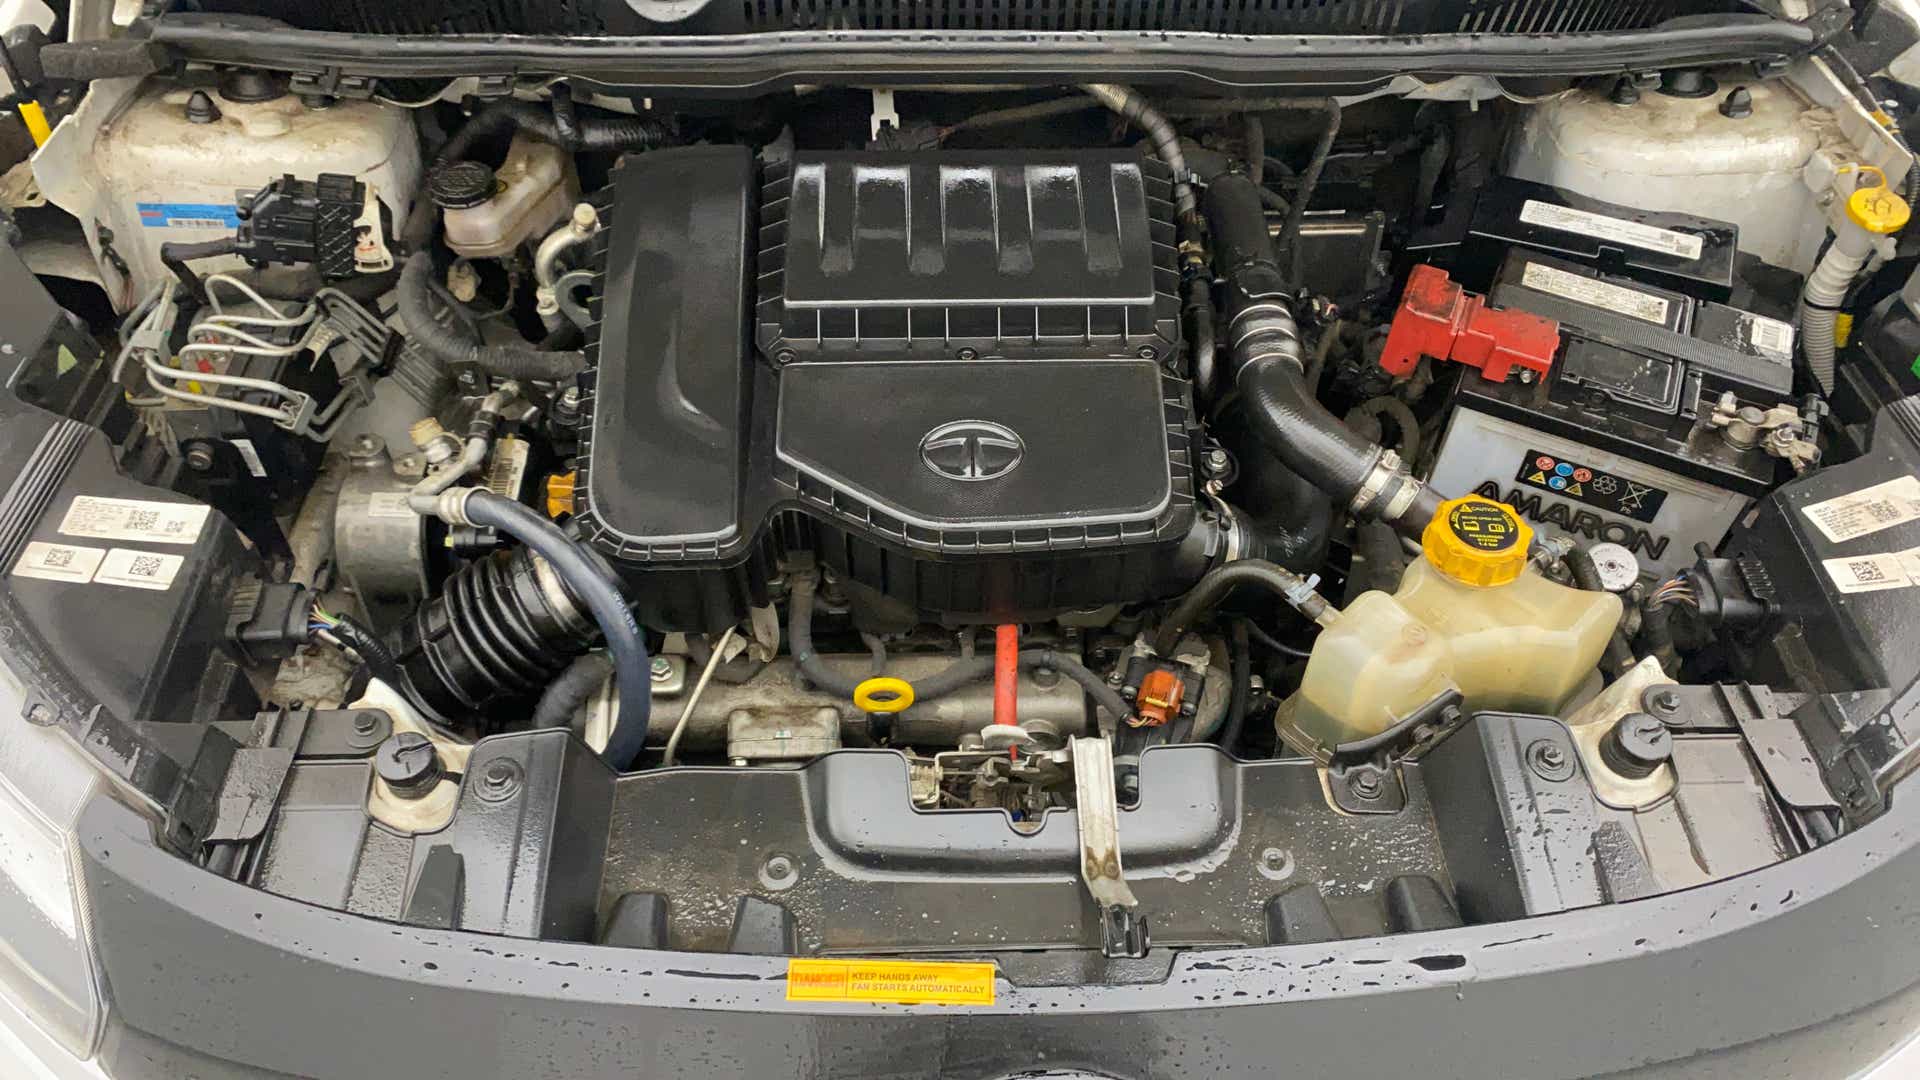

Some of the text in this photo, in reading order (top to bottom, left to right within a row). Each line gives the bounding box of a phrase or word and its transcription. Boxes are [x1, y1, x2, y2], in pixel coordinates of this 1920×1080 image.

[1473, 480, 1671, 561] AMARON
[852, 973, 938, 982] KEEP HANDS AWAY
[852, 982, 985, 994] FAN STARTS AUTOMATICALLY
